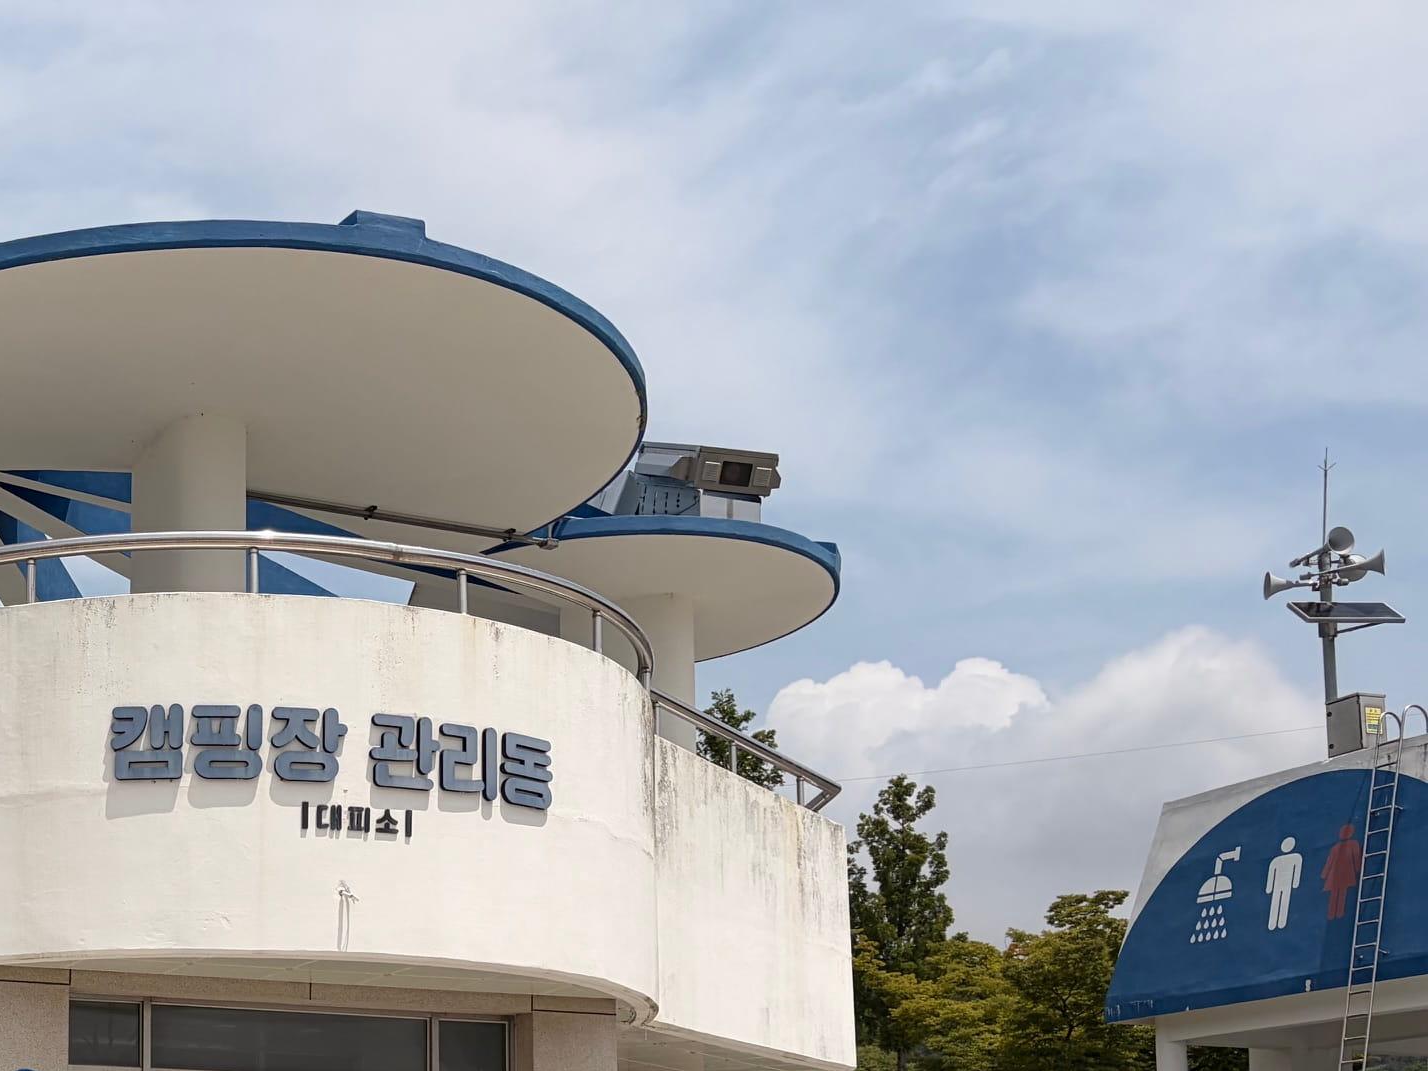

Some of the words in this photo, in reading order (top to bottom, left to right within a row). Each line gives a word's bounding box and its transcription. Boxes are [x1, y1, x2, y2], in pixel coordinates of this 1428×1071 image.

[110, 703, 348, 782] 캠핑장
[369, 712, 553, 811] 관리동
[315, 804, 399, 835] 대피소
